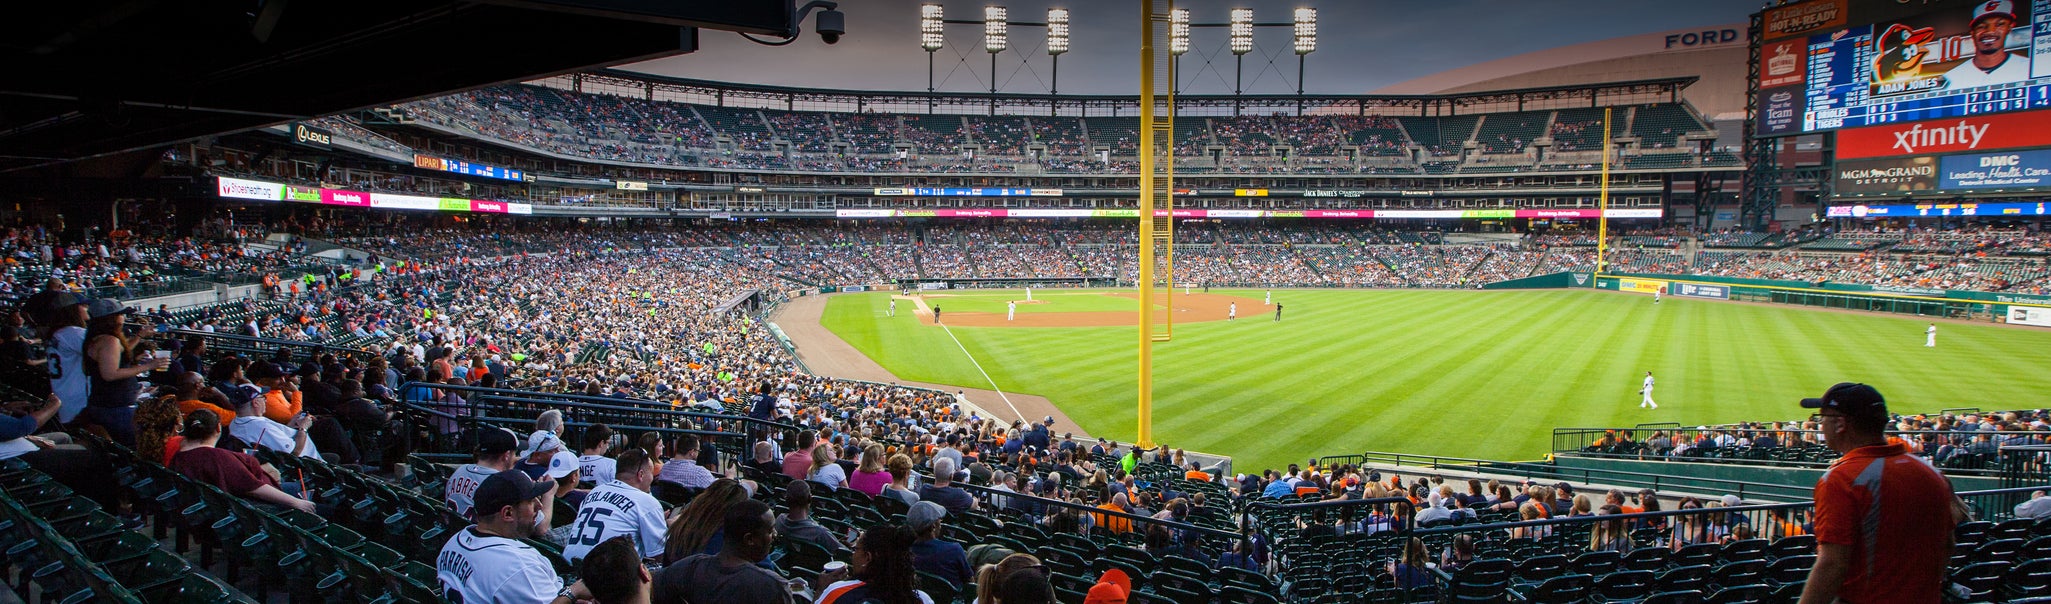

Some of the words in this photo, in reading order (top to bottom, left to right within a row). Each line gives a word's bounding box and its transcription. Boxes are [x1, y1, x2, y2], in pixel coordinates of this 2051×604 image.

[1769, 8, 1840, 32] HOT-N-READY
[1665, 29, 1738, 48] FORD
[1940, 37, 1962, 63] 10
[1878, 81, 1905, 94] ADAM
[1906, 77, 1938, 91] JONES
[1767, 108, 1793, 120] Team
[306, 130, 330, 145] LEXUS
[1892, 120, 1990, 153] xfinity
[418, 156, 439, 169] LIPARI
[1980, 155, 2020, 168] DMC
[1841, 169, 1871, 180] MGM
[1886, 166, 1932, 178] GRAND
[1856, 177, 1914, 185] DETROIT
[1681, 284, 1697, 295] Lite
[1996, 295, 2013, 303] The
[569, 507, 614, 547] 35
[440, 550, 474, 588] PARRISH
